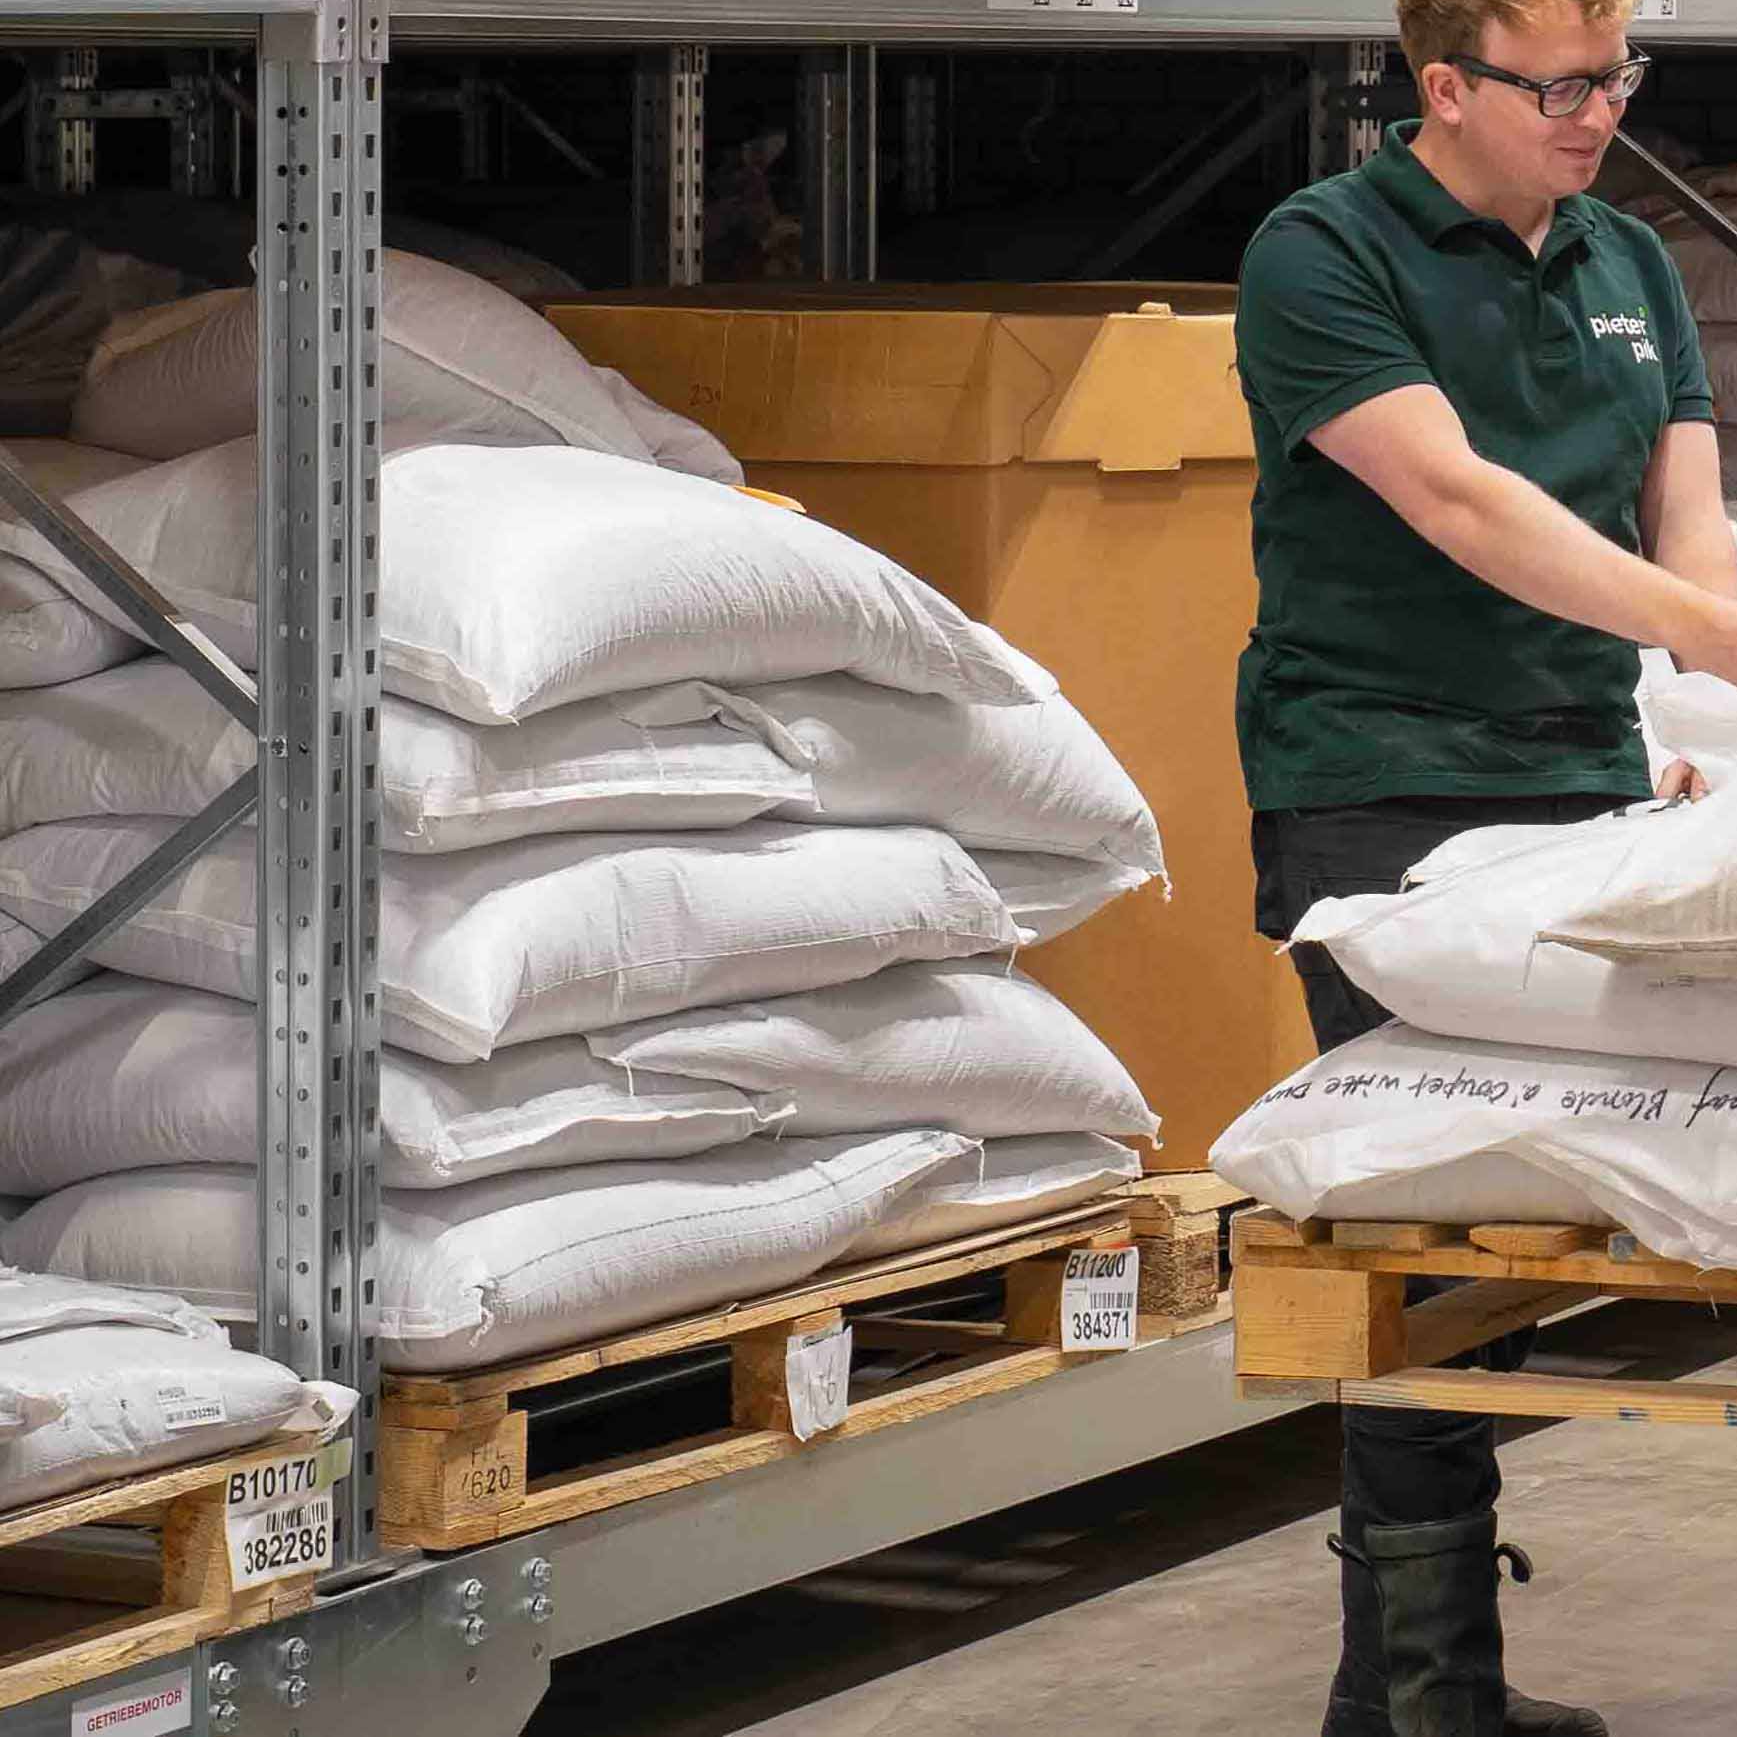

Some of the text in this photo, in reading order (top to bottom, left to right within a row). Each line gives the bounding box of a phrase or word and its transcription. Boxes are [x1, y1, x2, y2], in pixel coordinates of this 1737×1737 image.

[1589, 312, 1648, 340] pieter
[1560, 1088, 1668, 1121] Blonde
[1066, 1252, 1126, 1279] B11200
[1073, 1310, 1129, 1340] 384371
[228, 1458, 317, 1505] B10170
[244, 1525, 327, 1575] 382286
[87, 1690, 183, 1732] GETRIEBEMOTOR
